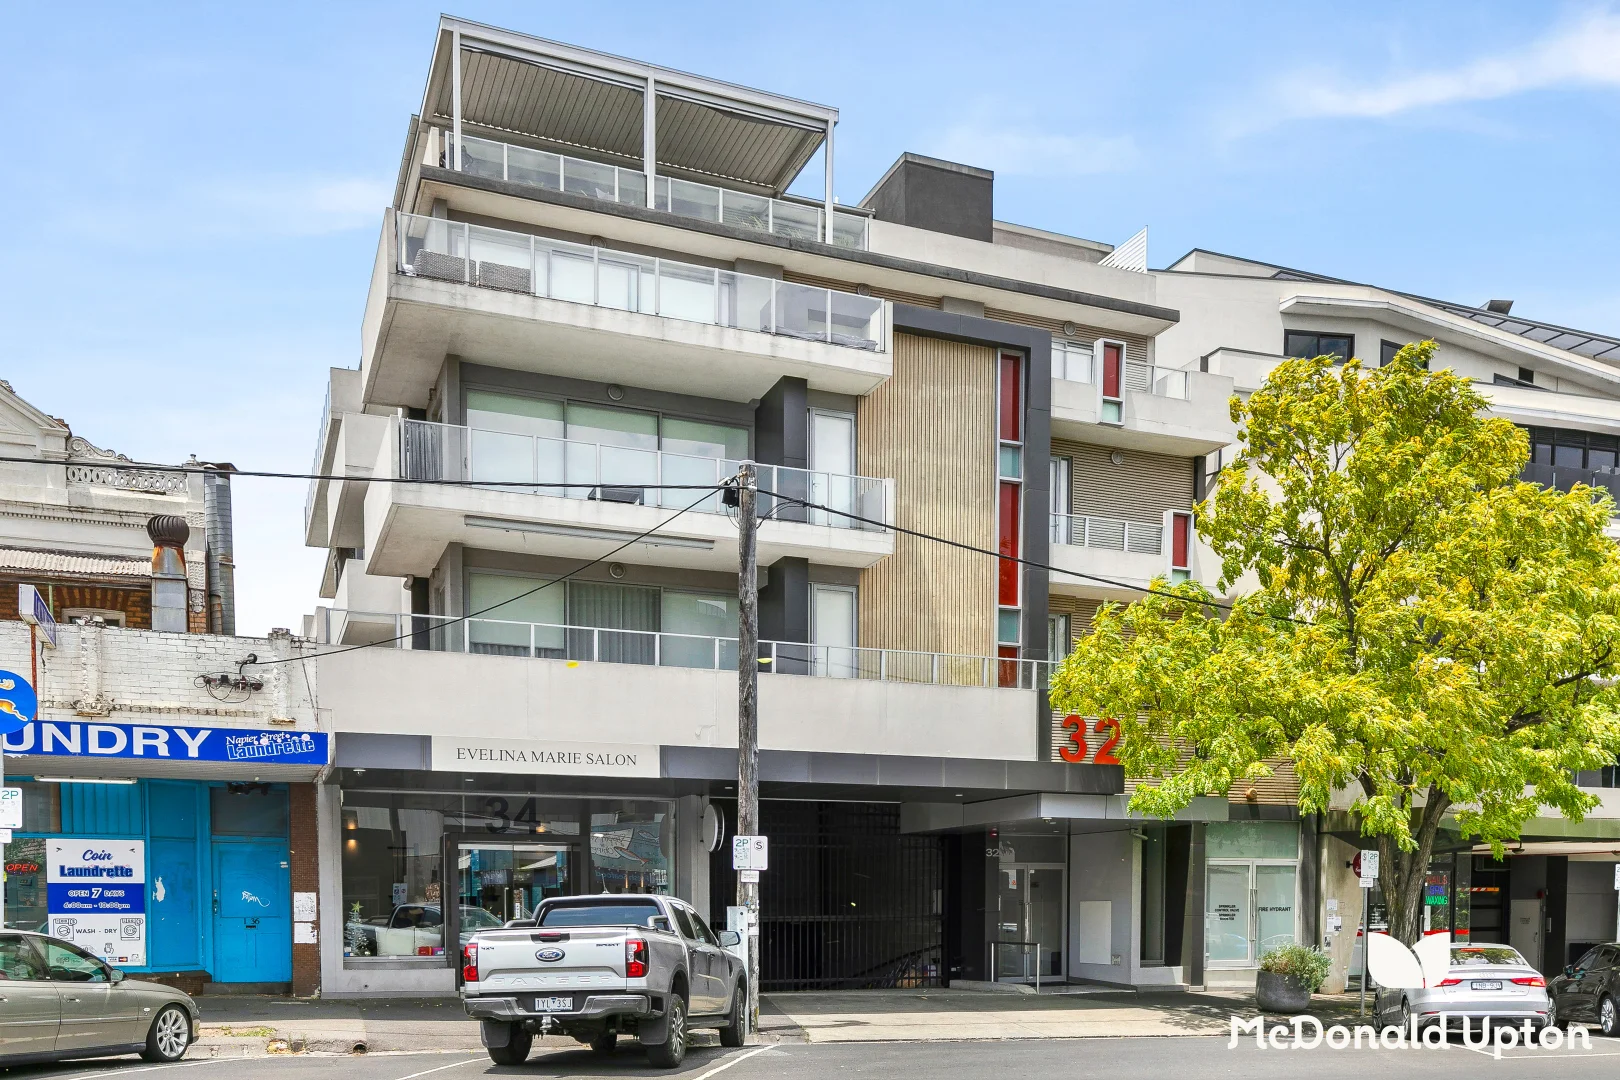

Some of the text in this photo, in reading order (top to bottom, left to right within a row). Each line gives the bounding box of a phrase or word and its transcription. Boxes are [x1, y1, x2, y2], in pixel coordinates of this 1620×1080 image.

[2, 722, 212, 757] UNDRY
[225, 732, 285, 746] Napier Street
[1059, 714, 1120, 764] 32
[227, 740, 315, 760] Laundrette
[456, 748, 637, 766] EVELINA MARIE SALON
[2, 790, 19, 800] 2P
[485, 796, 541, 835] 34
[735, 838, 749, 847] 2P
[82, 849, 113, 861] Coin
[985, 848, 1000, 857] 32
[6, 864, 39, 872] OPEN
[59, 865, 134, 878] Laundrette
[1426, 875, 1448, 884] NAILS
[91, 888, 102, 899] 7
[1429, 885, 1445, 895] SPA
[1425, 896, 1448, 905] WAXING
[250, 917, 260, 925] 36
[494, 975, 613, 985] RANGER
